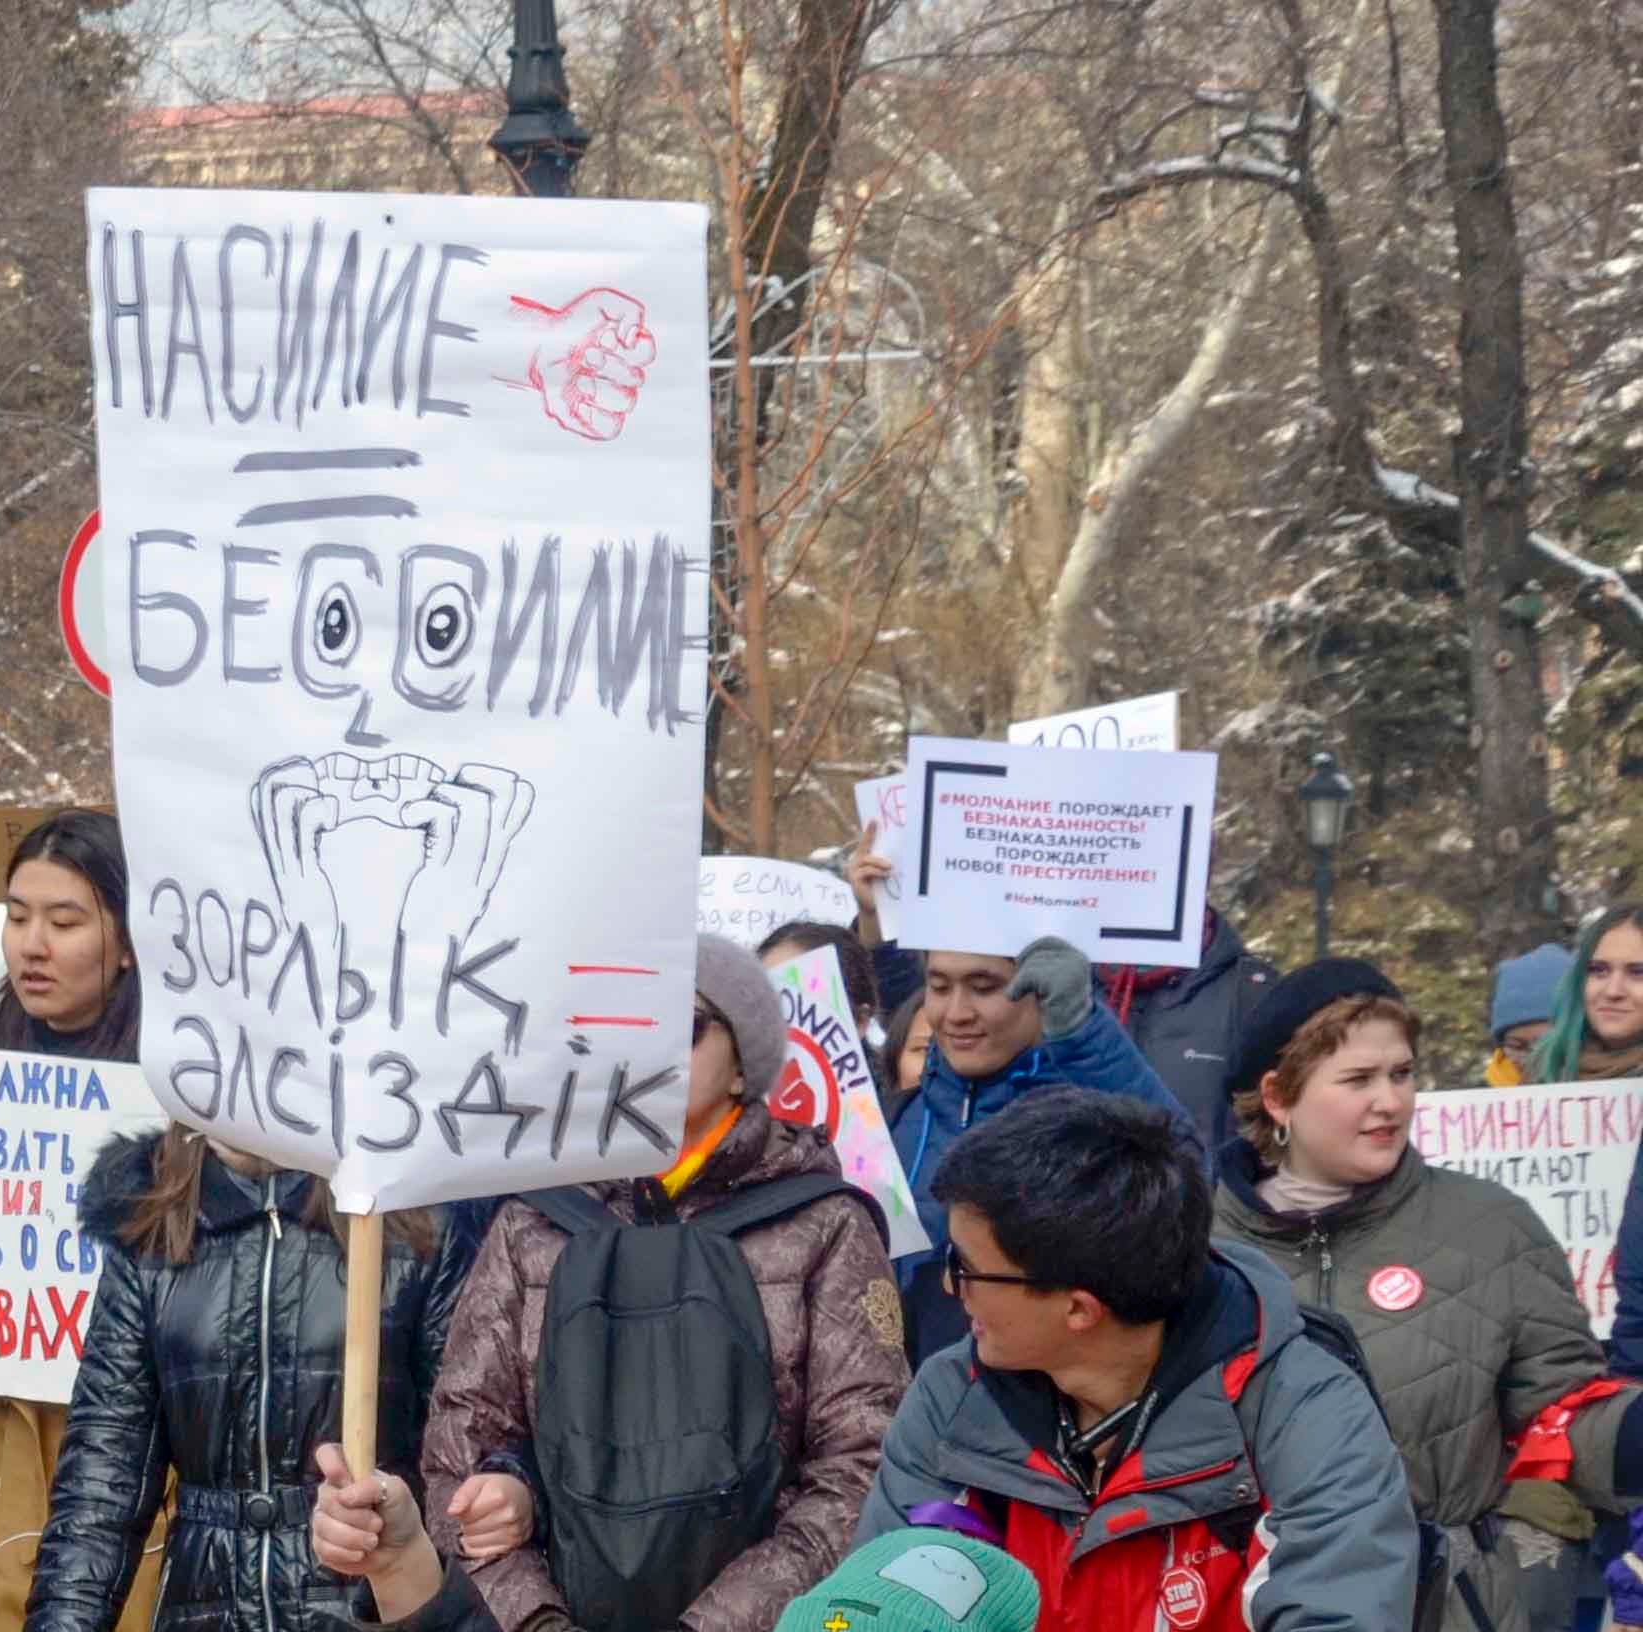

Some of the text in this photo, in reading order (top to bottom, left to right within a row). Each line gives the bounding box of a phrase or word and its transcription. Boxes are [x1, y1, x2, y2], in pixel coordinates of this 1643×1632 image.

[102, 217, 491, 432] НАСИЛИЕ
[938, 792, 1174, 819] #МОЛЧАНИЕ ПОРОЖДАЕТ
[963, 811, 1147, 833] БЕЗНАКАЗАННОСТЬ!
[965, 827, 1141, 850] БЕЗНАКАЗАННОСТЬ
[995, 846, 1109, 866] ПОРОЖДАЕТ
[945, 858, 1157, 883] НОВОЕ ПРЕСТУПЛЕНИЕ!
[1415, 1093, 1643, 1159] ЕМИНИСТКИ
[1549, 1189, 1613, 1240] ТЫ
[20, 1224, 39, 1272] О
[1164, 1580, 1194, 1603] STOP
